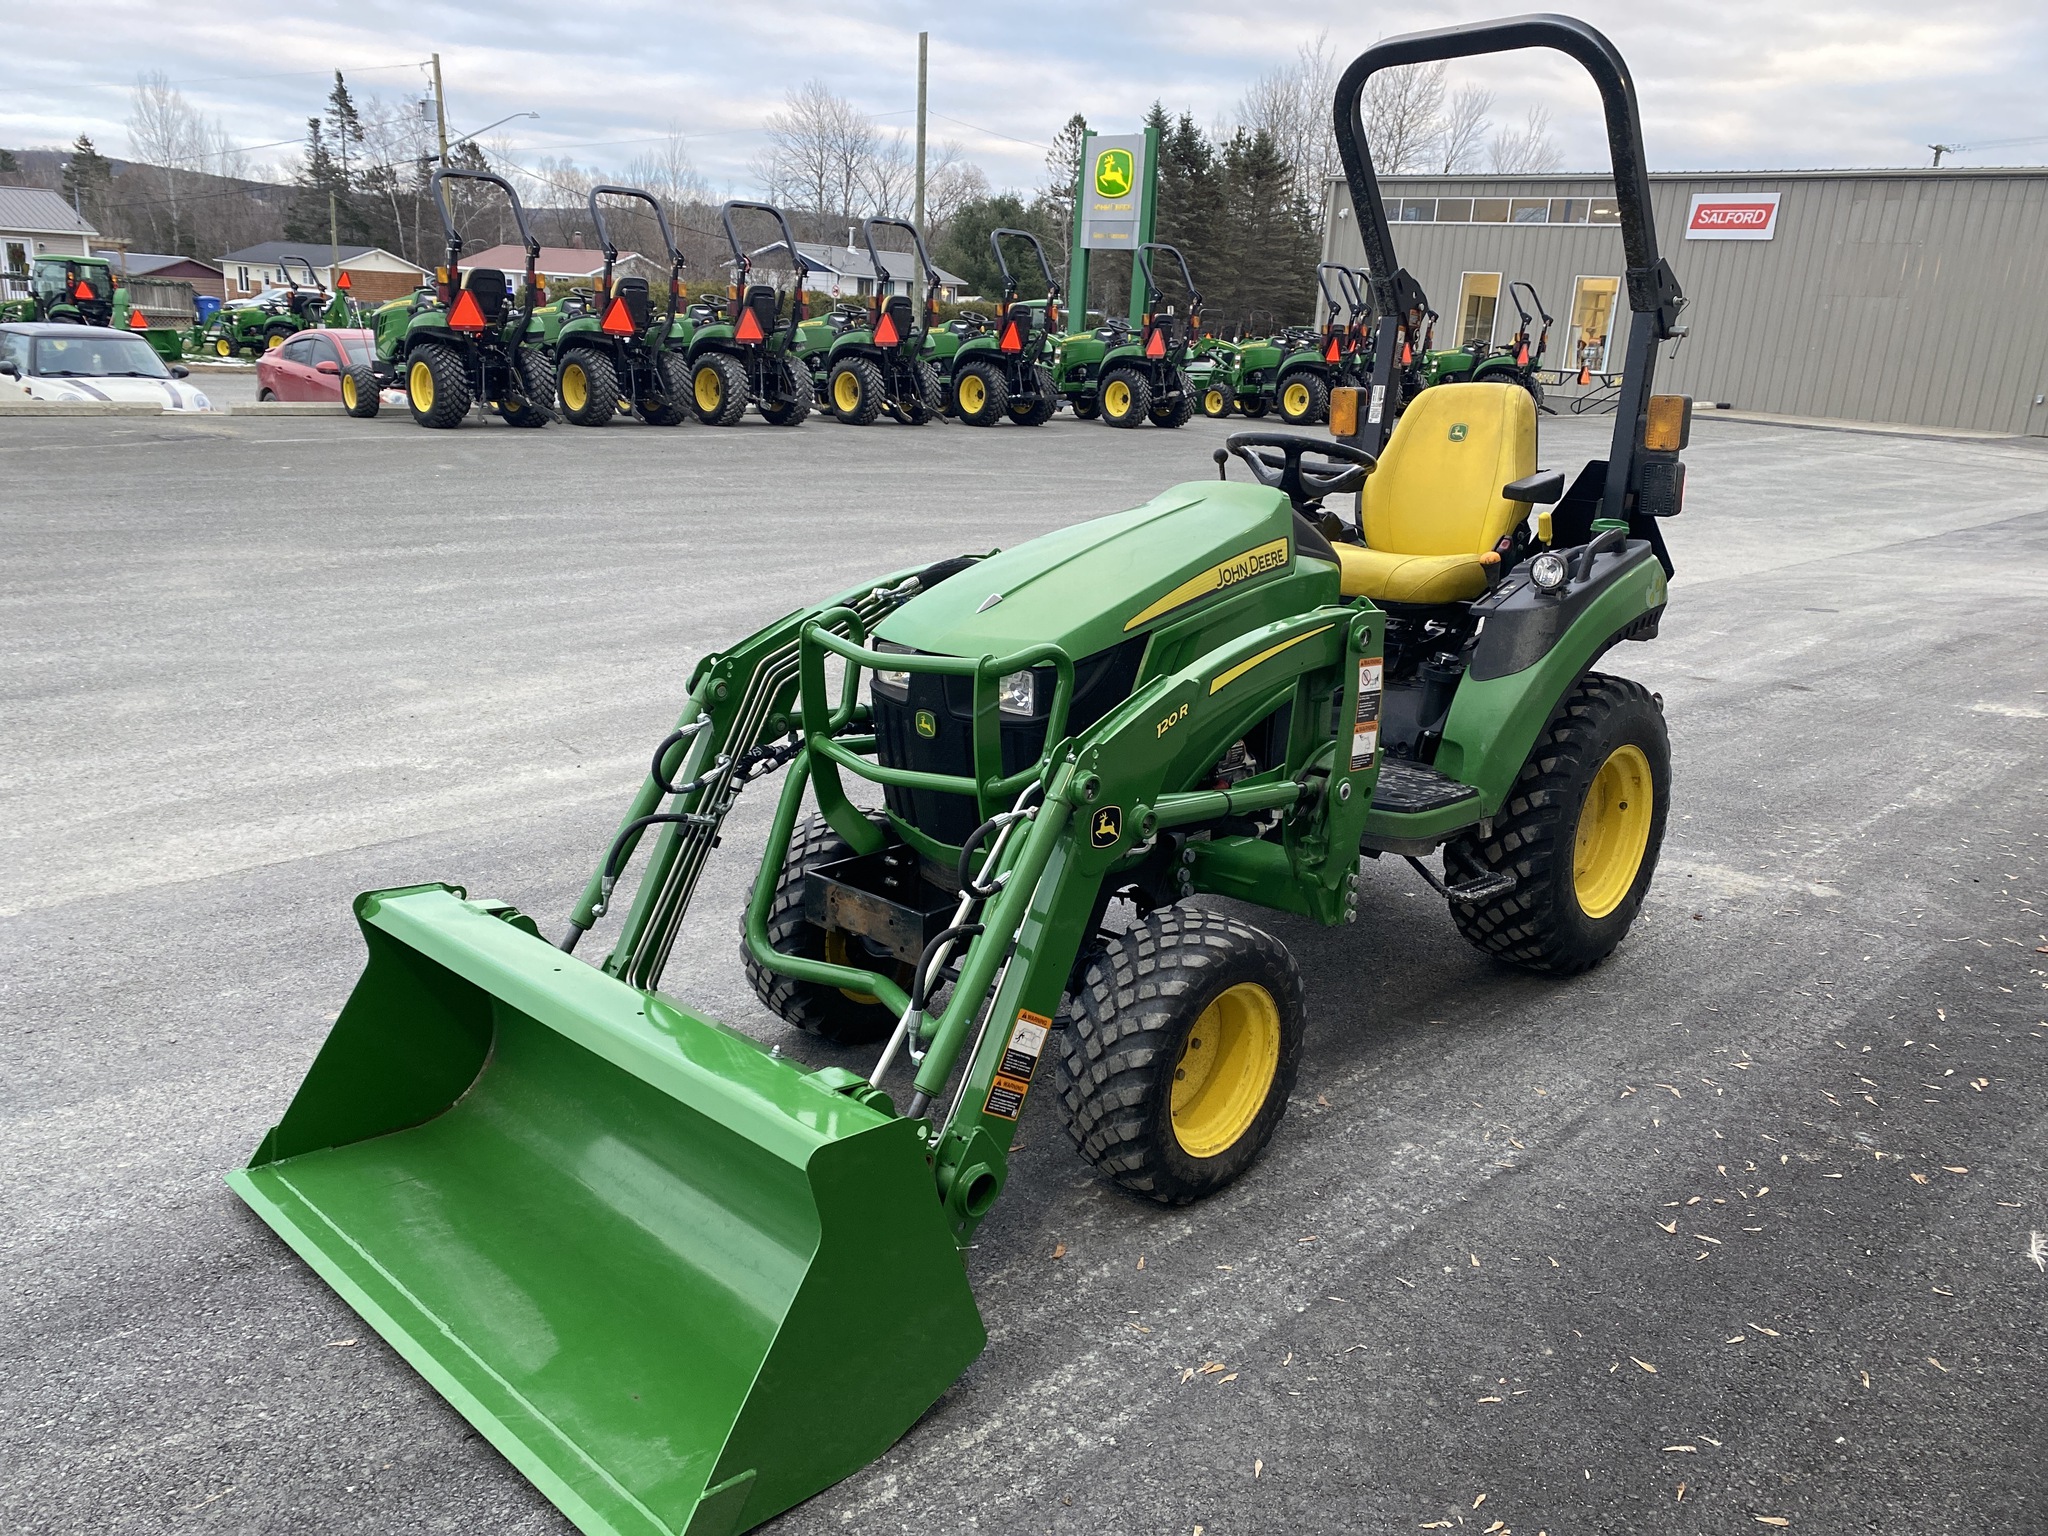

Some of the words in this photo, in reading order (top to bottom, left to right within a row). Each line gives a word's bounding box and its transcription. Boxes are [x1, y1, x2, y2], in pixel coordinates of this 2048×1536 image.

[1698, 209, 1767, 224] SALFORD
[1216, 562, 1249, 588] JOHN
[1248, 548, 1285, 575] DEERE
[1027, 1013, 1048, 1026] WARNING
[1003, 1081, 1024, 1092] WARNING
